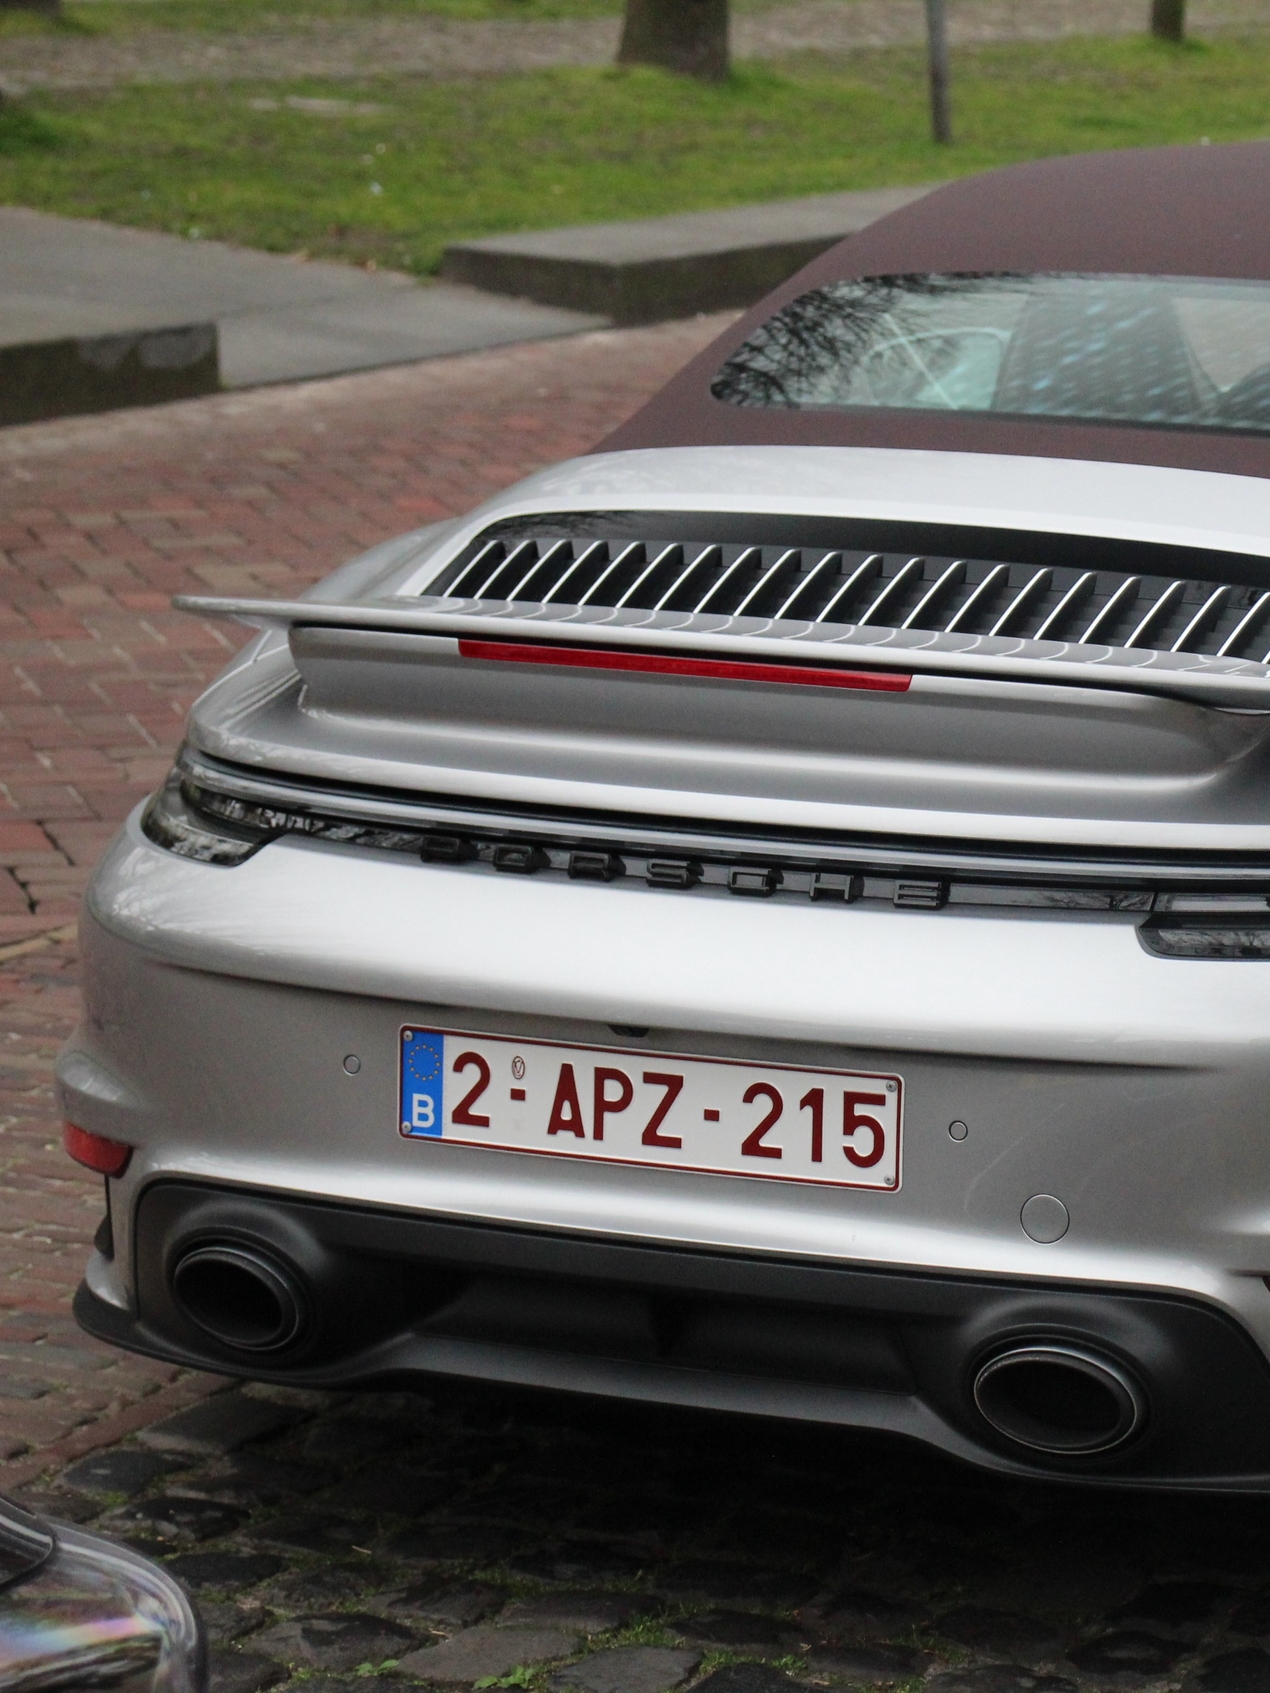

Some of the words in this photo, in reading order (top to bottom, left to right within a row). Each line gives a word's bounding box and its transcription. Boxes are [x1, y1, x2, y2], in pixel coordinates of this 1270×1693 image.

[420, 836, 945, 909] PORSCHE
[412, 1094, 436, 1128] B
[452, 1051, 887, 1169] 2-APZ-215
